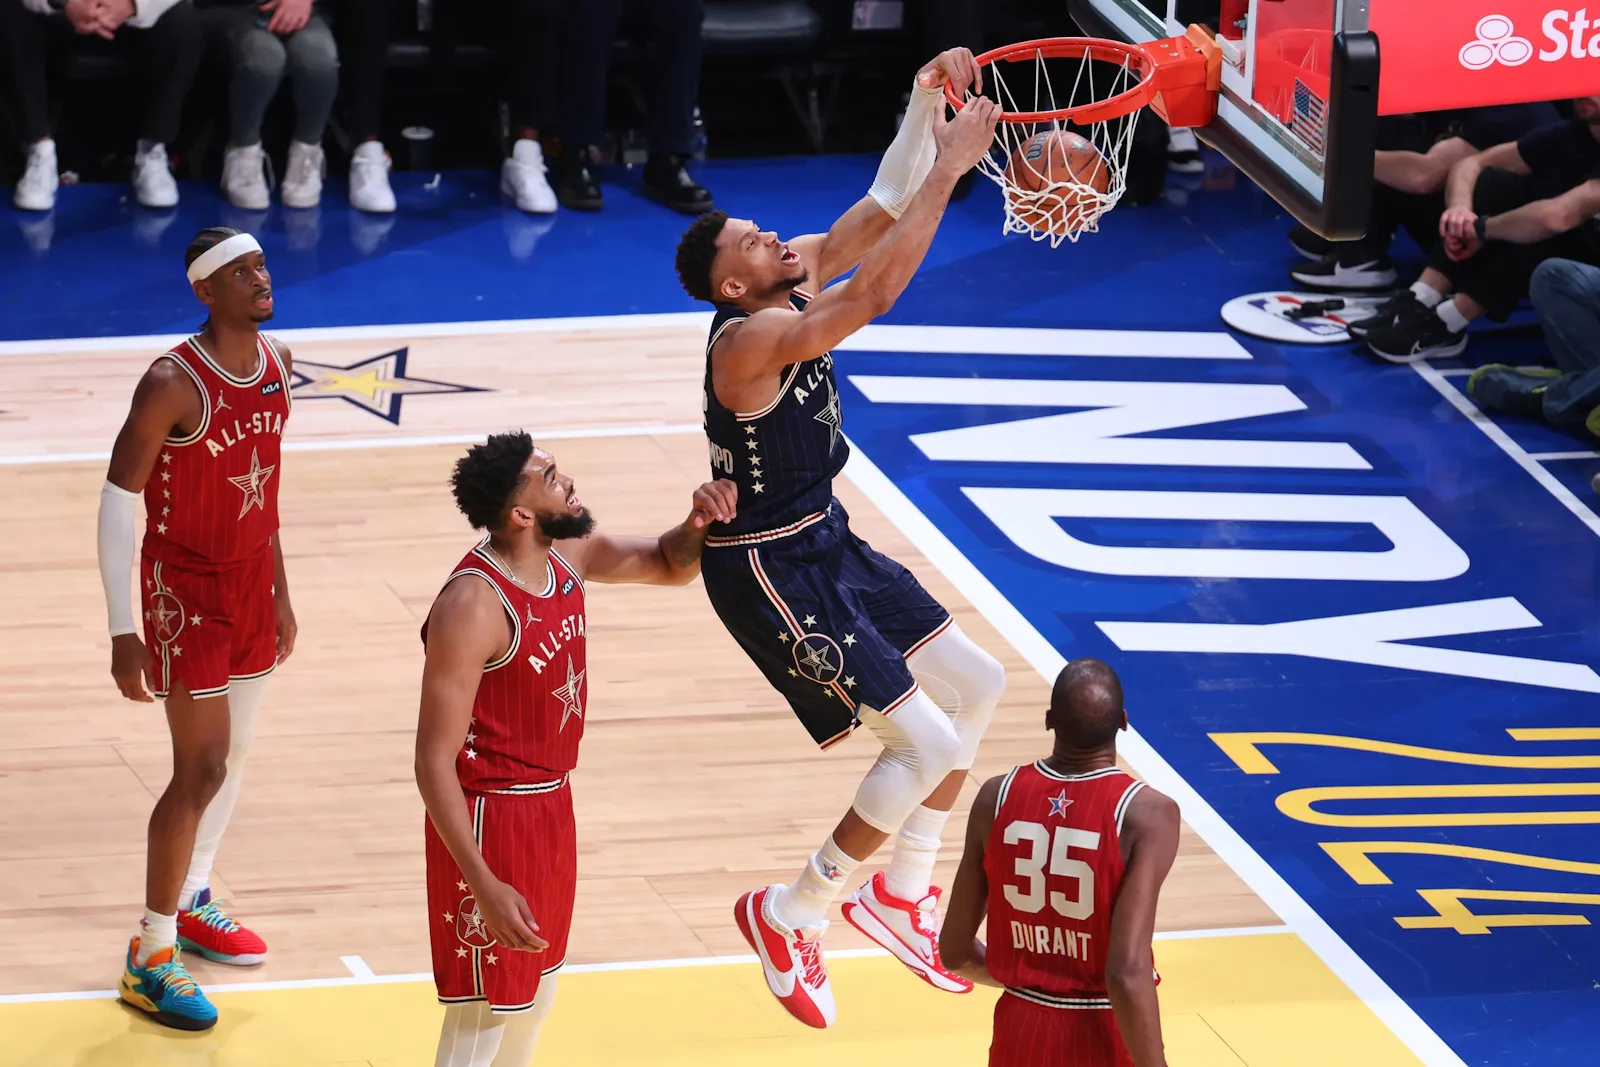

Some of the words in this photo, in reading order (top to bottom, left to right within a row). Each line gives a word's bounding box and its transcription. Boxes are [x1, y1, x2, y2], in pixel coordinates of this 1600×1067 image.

[832, 325, 1600, 693] INDY
[528, 614, 587, 675] ALL-STA
[1003, 820, 1100, 920] 35
[1207, 727, 1600, 935] 2024
[1010, 921, 1092, 961] DURANT
